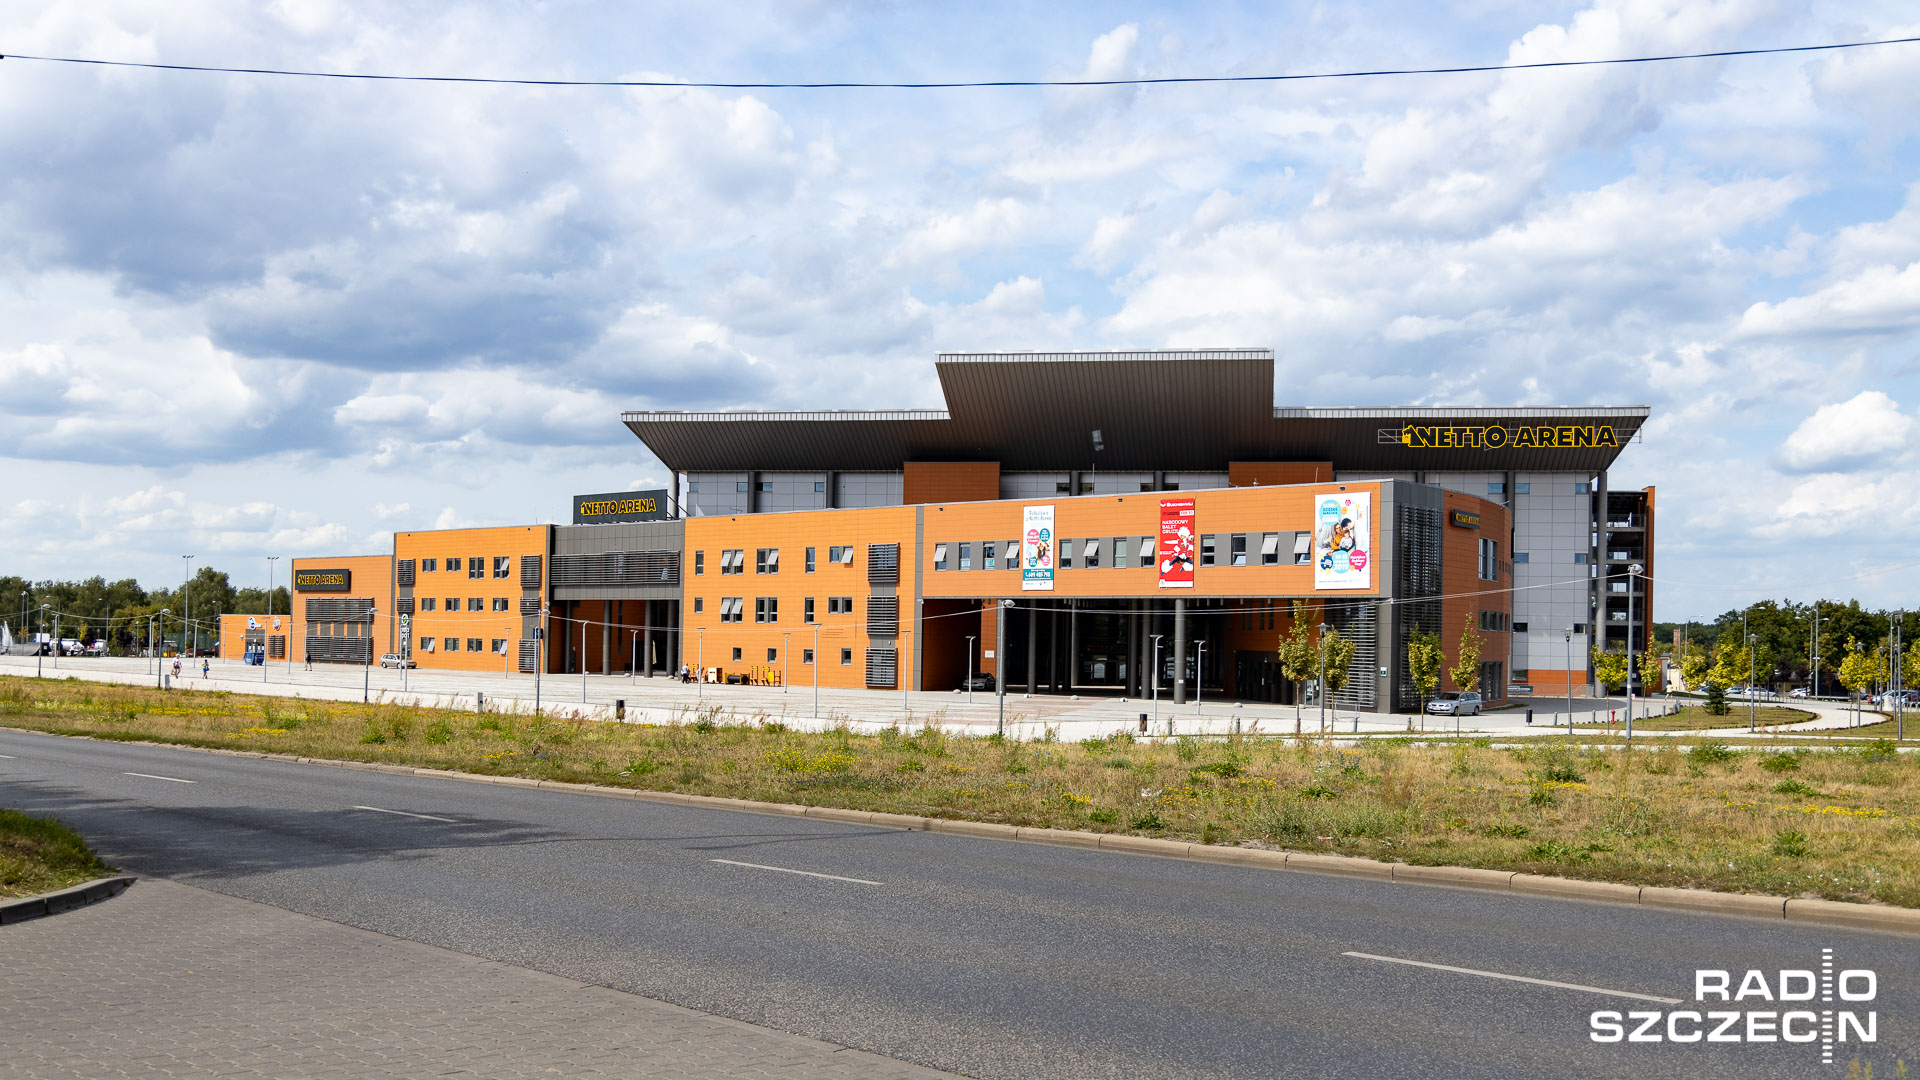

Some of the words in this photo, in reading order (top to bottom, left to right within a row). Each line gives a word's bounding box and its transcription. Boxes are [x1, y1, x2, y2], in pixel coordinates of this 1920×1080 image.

[1403, 425, 1507, 448] NETTO
[1513, 425, 1618, 447] ARENA
[581, 500, 618, 515] NETTO
[618, 498, 656, 513] ARENA
[298, 574, 320, 585] NETTO
[321, 574, 344, 584] ARENA
